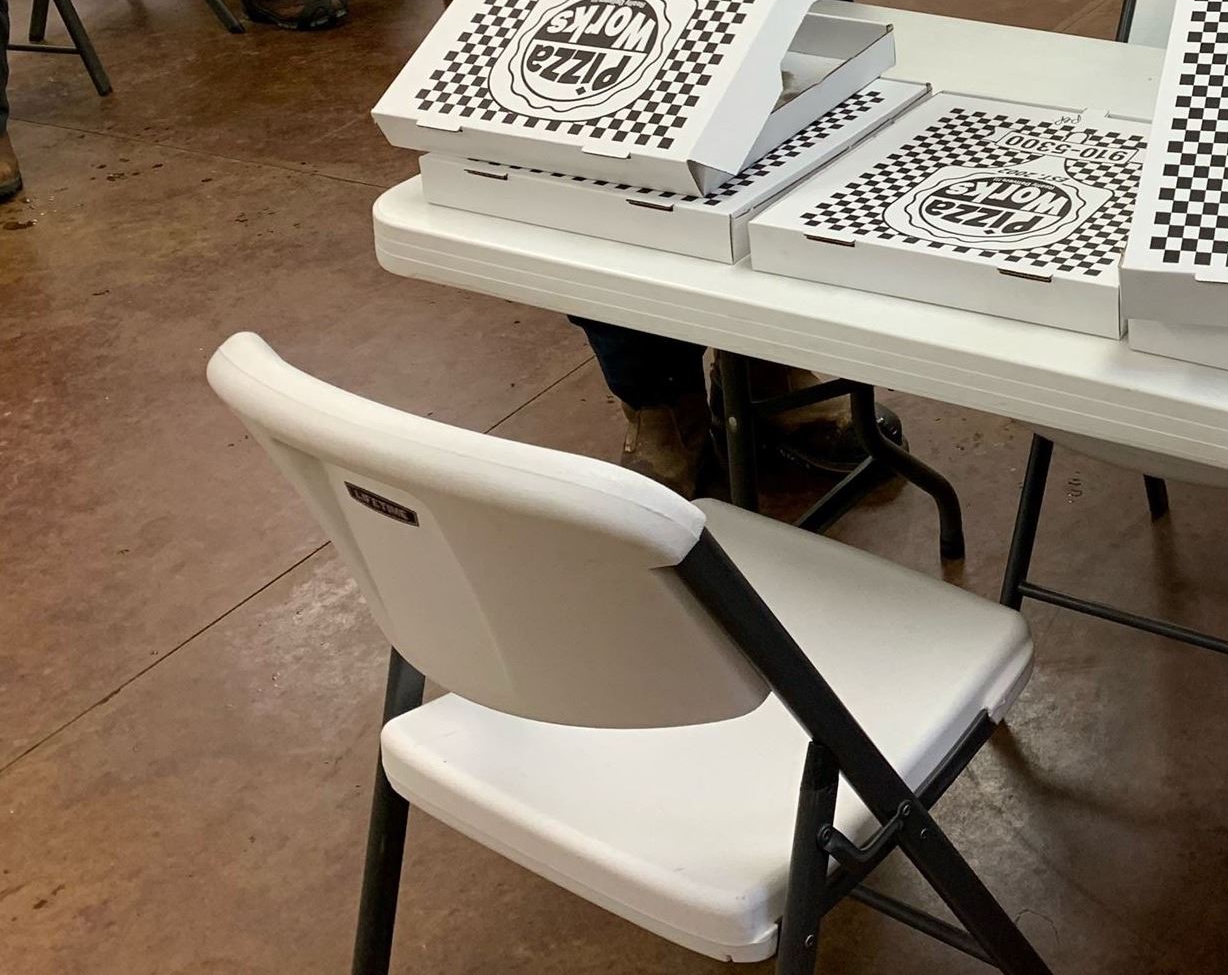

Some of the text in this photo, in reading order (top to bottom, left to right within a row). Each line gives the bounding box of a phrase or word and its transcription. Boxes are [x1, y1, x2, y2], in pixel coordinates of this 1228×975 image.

[546, 5, 657, 52] Works
[526, 44, 633, 96] Pizza
[1005, 135, 1128, 162] 910-5300
[945, 181, 1069, 216] Works
[925, 199, 1045, 235] Pizza
